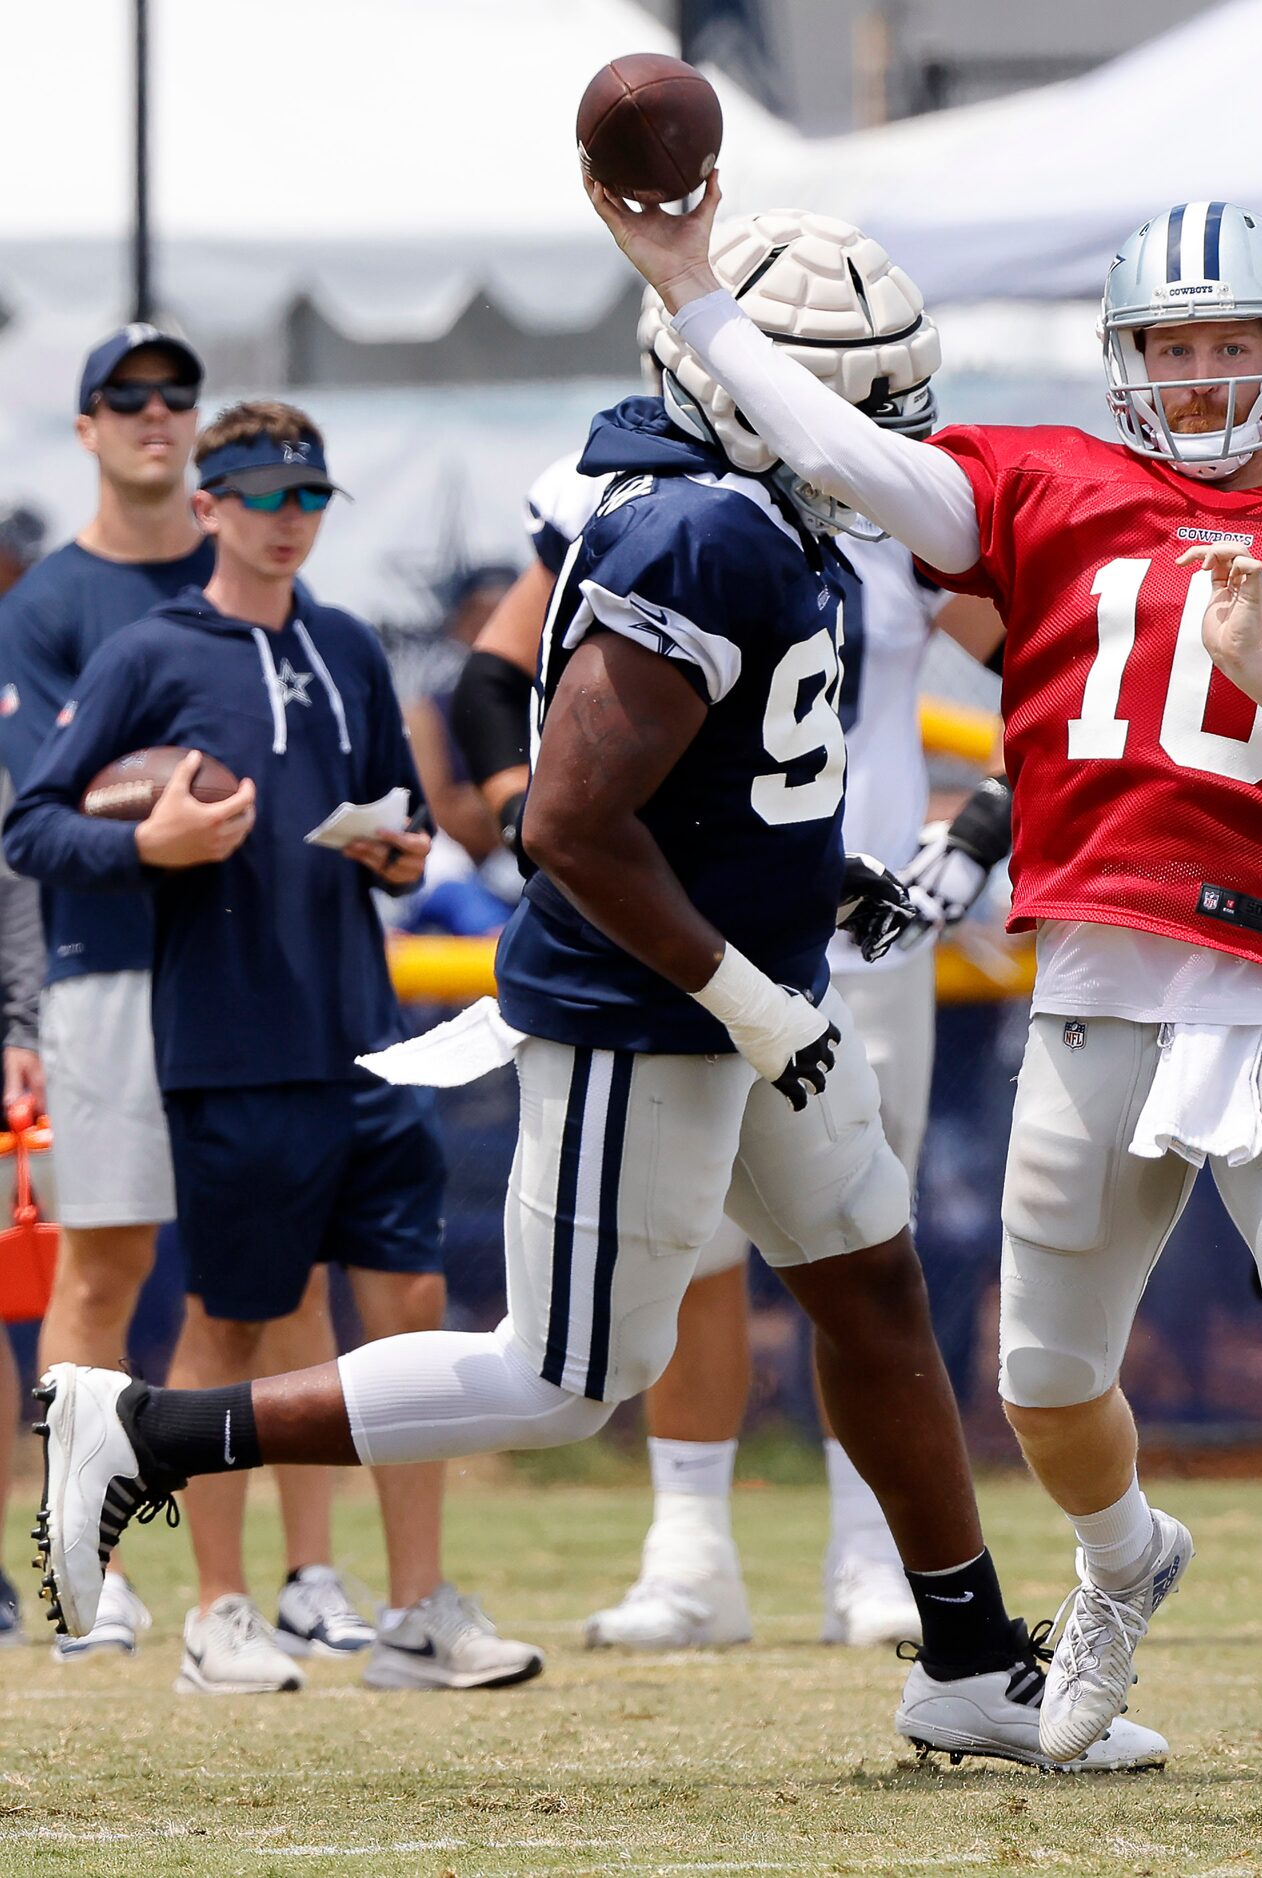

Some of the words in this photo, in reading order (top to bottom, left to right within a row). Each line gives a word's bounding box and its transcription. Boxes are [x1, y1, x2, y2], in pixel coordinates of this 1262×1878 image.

[1169, 286, 1213, 296] COWBOYS
[1177, 527, 1253, 547] COWBOYS
[750, 599, 847, 826] 9
[1065, 1031, 1083, 1045] NFL
